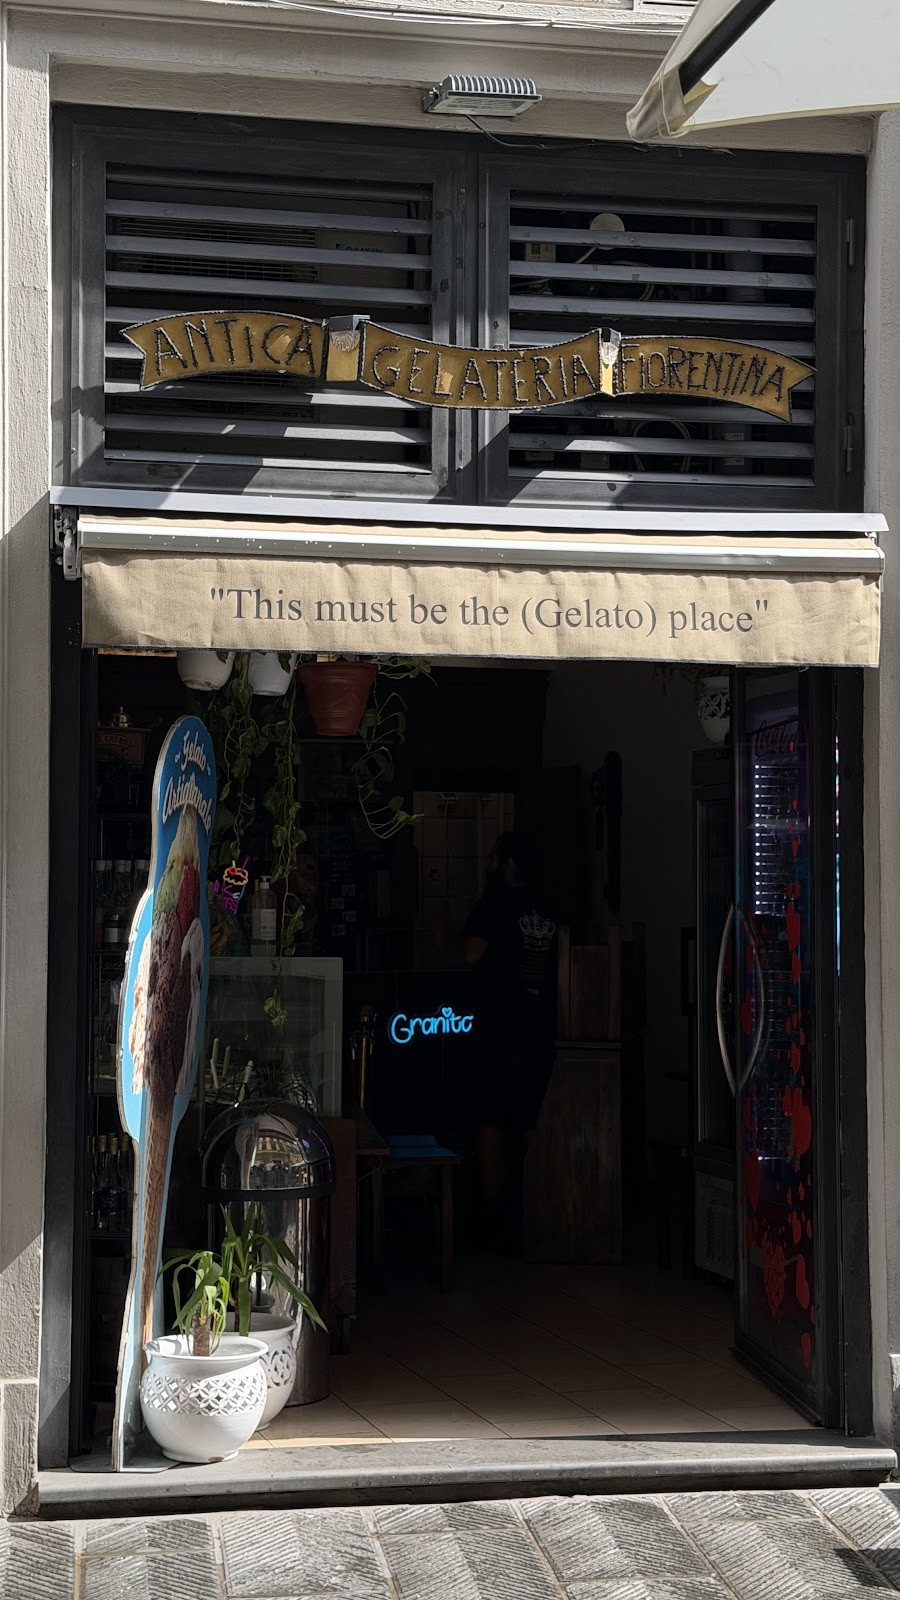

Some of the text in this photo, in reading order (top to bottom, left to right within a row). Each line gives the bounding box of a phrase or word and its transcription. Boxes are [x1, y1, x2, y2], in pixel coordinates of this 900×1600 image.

[154, 317, 787, 404] ANTICA GELATERIA FIORENTINA
[210, 587, 769, 640] "This must be the (Gelato) place"
